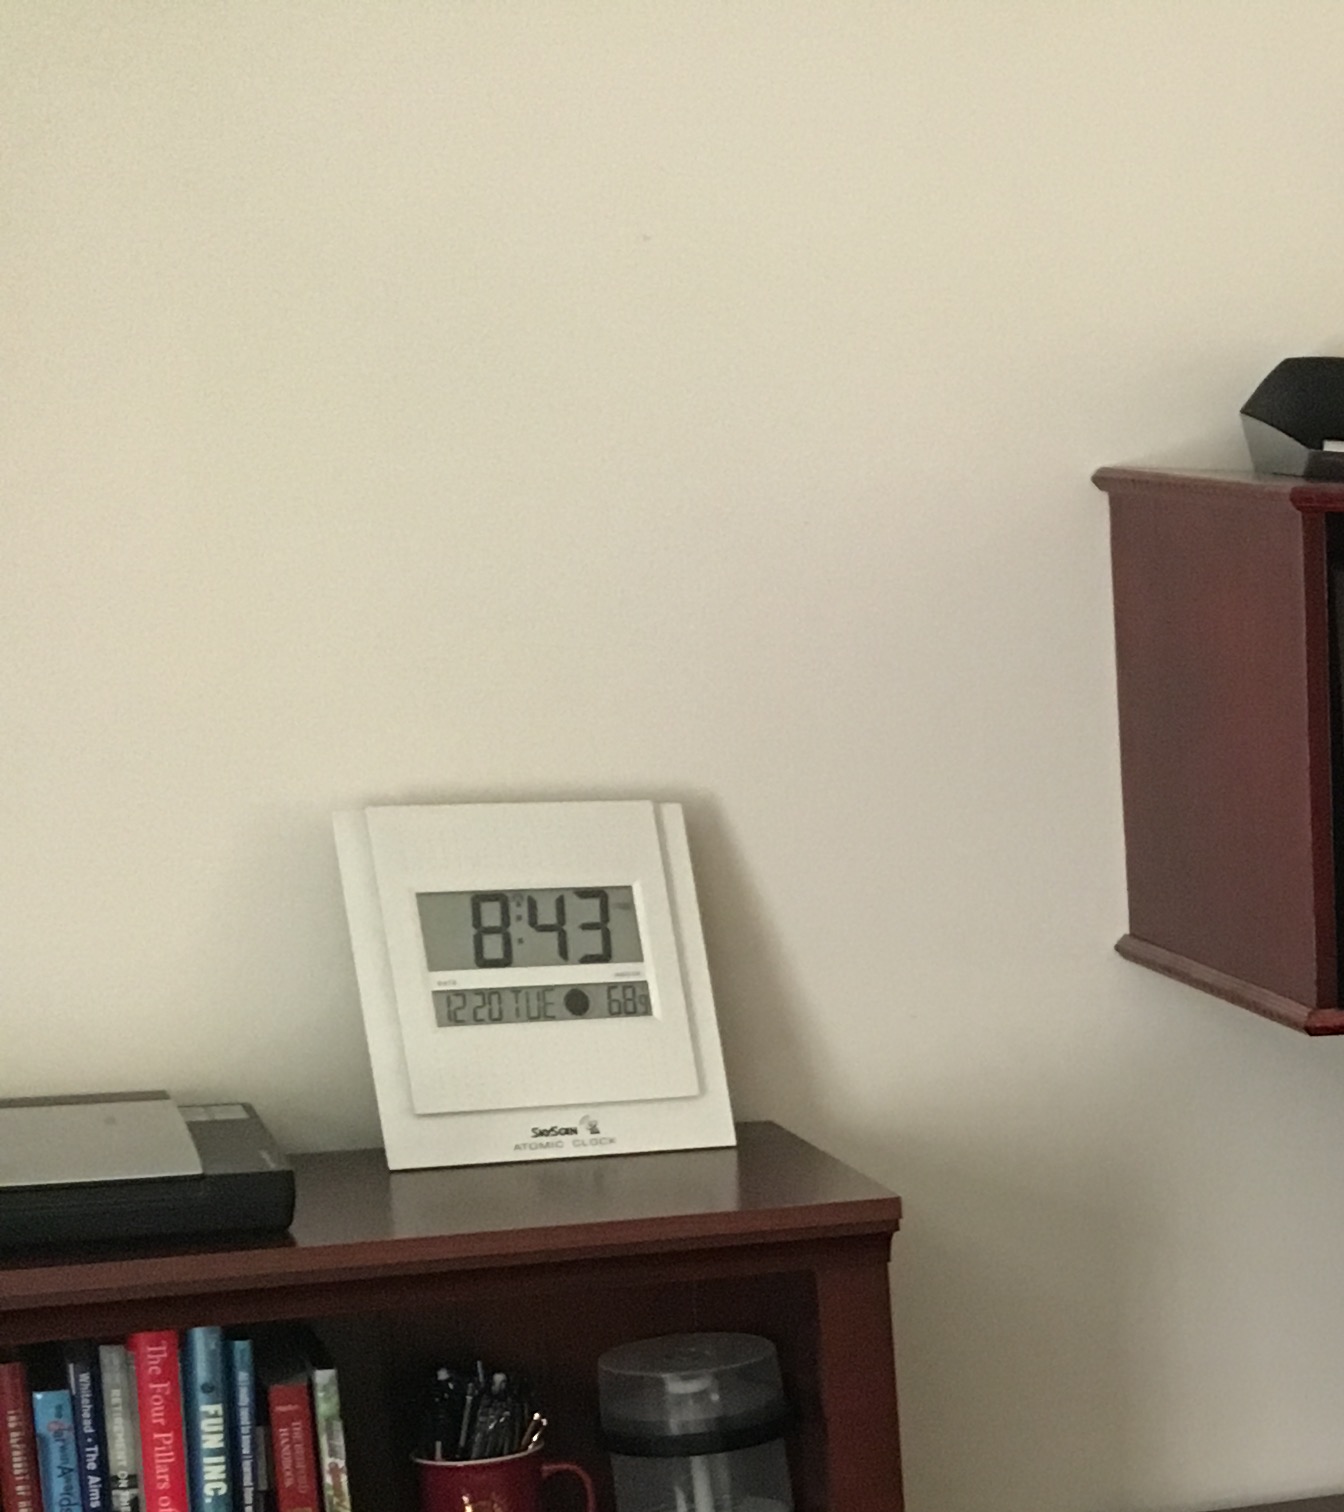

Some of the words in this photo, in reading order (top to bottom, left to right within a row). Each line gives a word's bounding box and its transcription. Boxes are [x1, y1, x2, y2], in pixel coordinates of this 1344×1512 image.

[470, 889, 613, 968] 8:43
[146, 1340, 168, 1376] The
[79, 1371, 97, 1434] Whitehead
[149, 1381, 172, 1426] Four
[200, 1403, 225, 1449] FUN
[85, 1444, 98, 1471] The
[154, 1431, 175, 1492] Pillars
[202, 1455, 228, 1504] INC.
[88, 1474, 102, 1508] Aims
